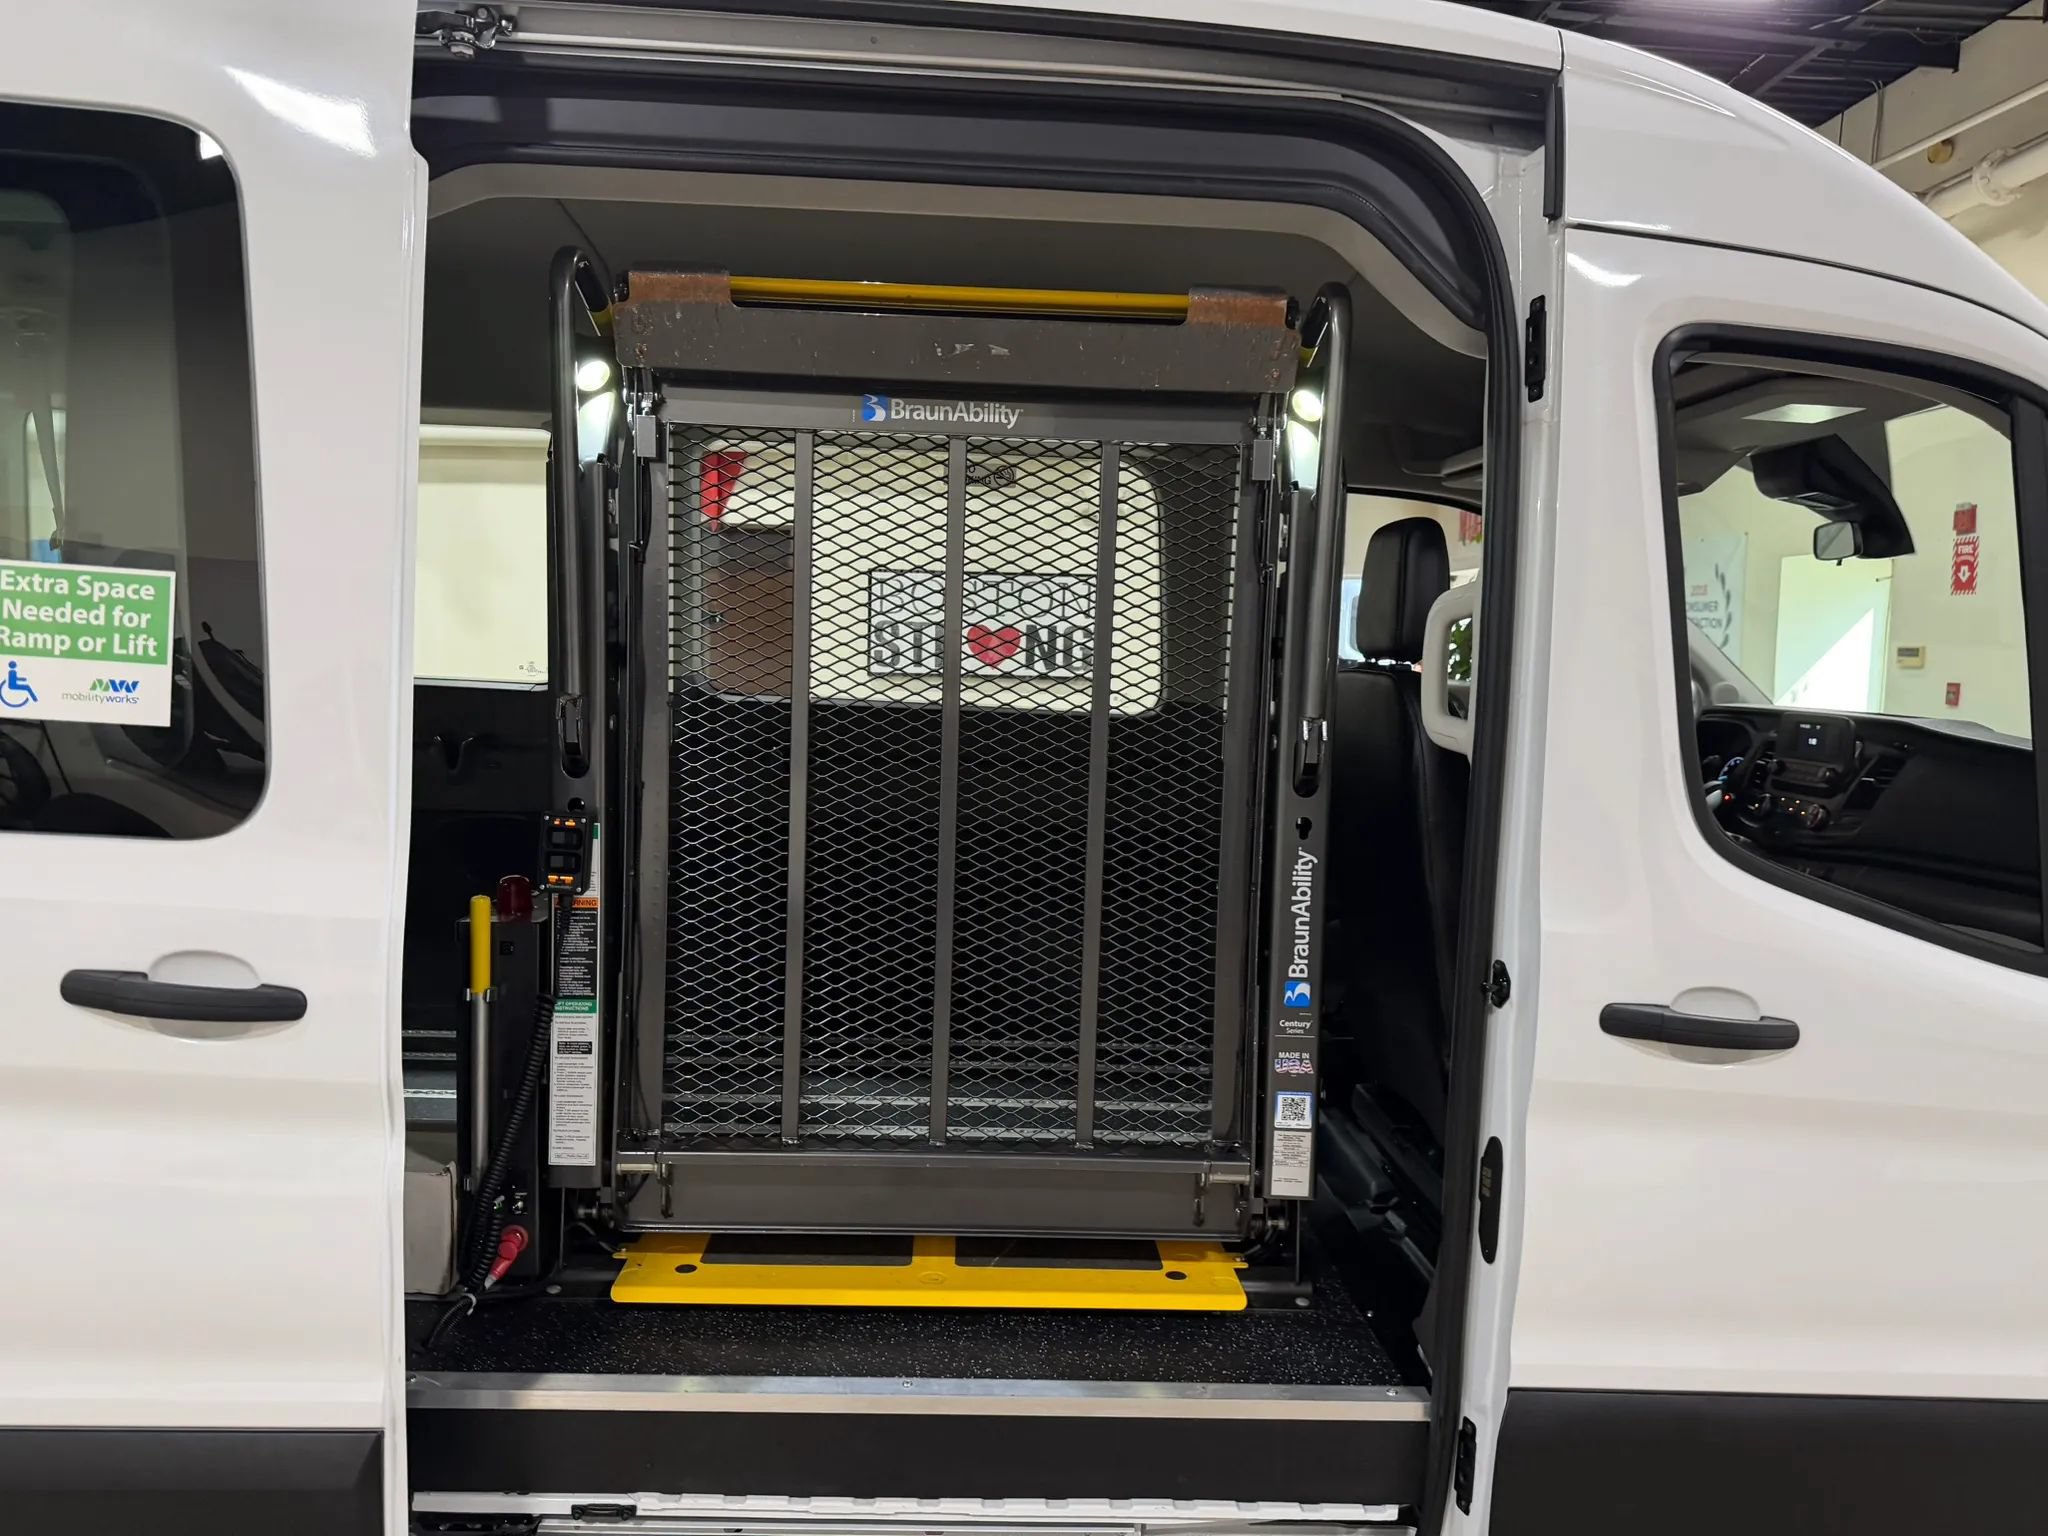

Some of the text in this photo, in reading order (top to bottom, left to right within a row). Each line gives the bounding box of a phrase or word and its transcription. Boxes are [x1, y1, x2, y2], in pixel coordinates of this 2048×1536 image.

[891, 398, 1020, 430] BraunAbility
[0, 569, 156, 603] Extra Space
[2, 597, 152, 629] Needed for
[0, 625, 158, 657] Ramp or Lift
[61, 692, 139, 705] mobilityworks
[1288, 848, 1318, 978] BraunAbility
[1279, 1019, 1311, 1030] Century
[1274, 1058, 1315, 1075] USA
[1278, 1051, 1311, 1060] MADE IN
